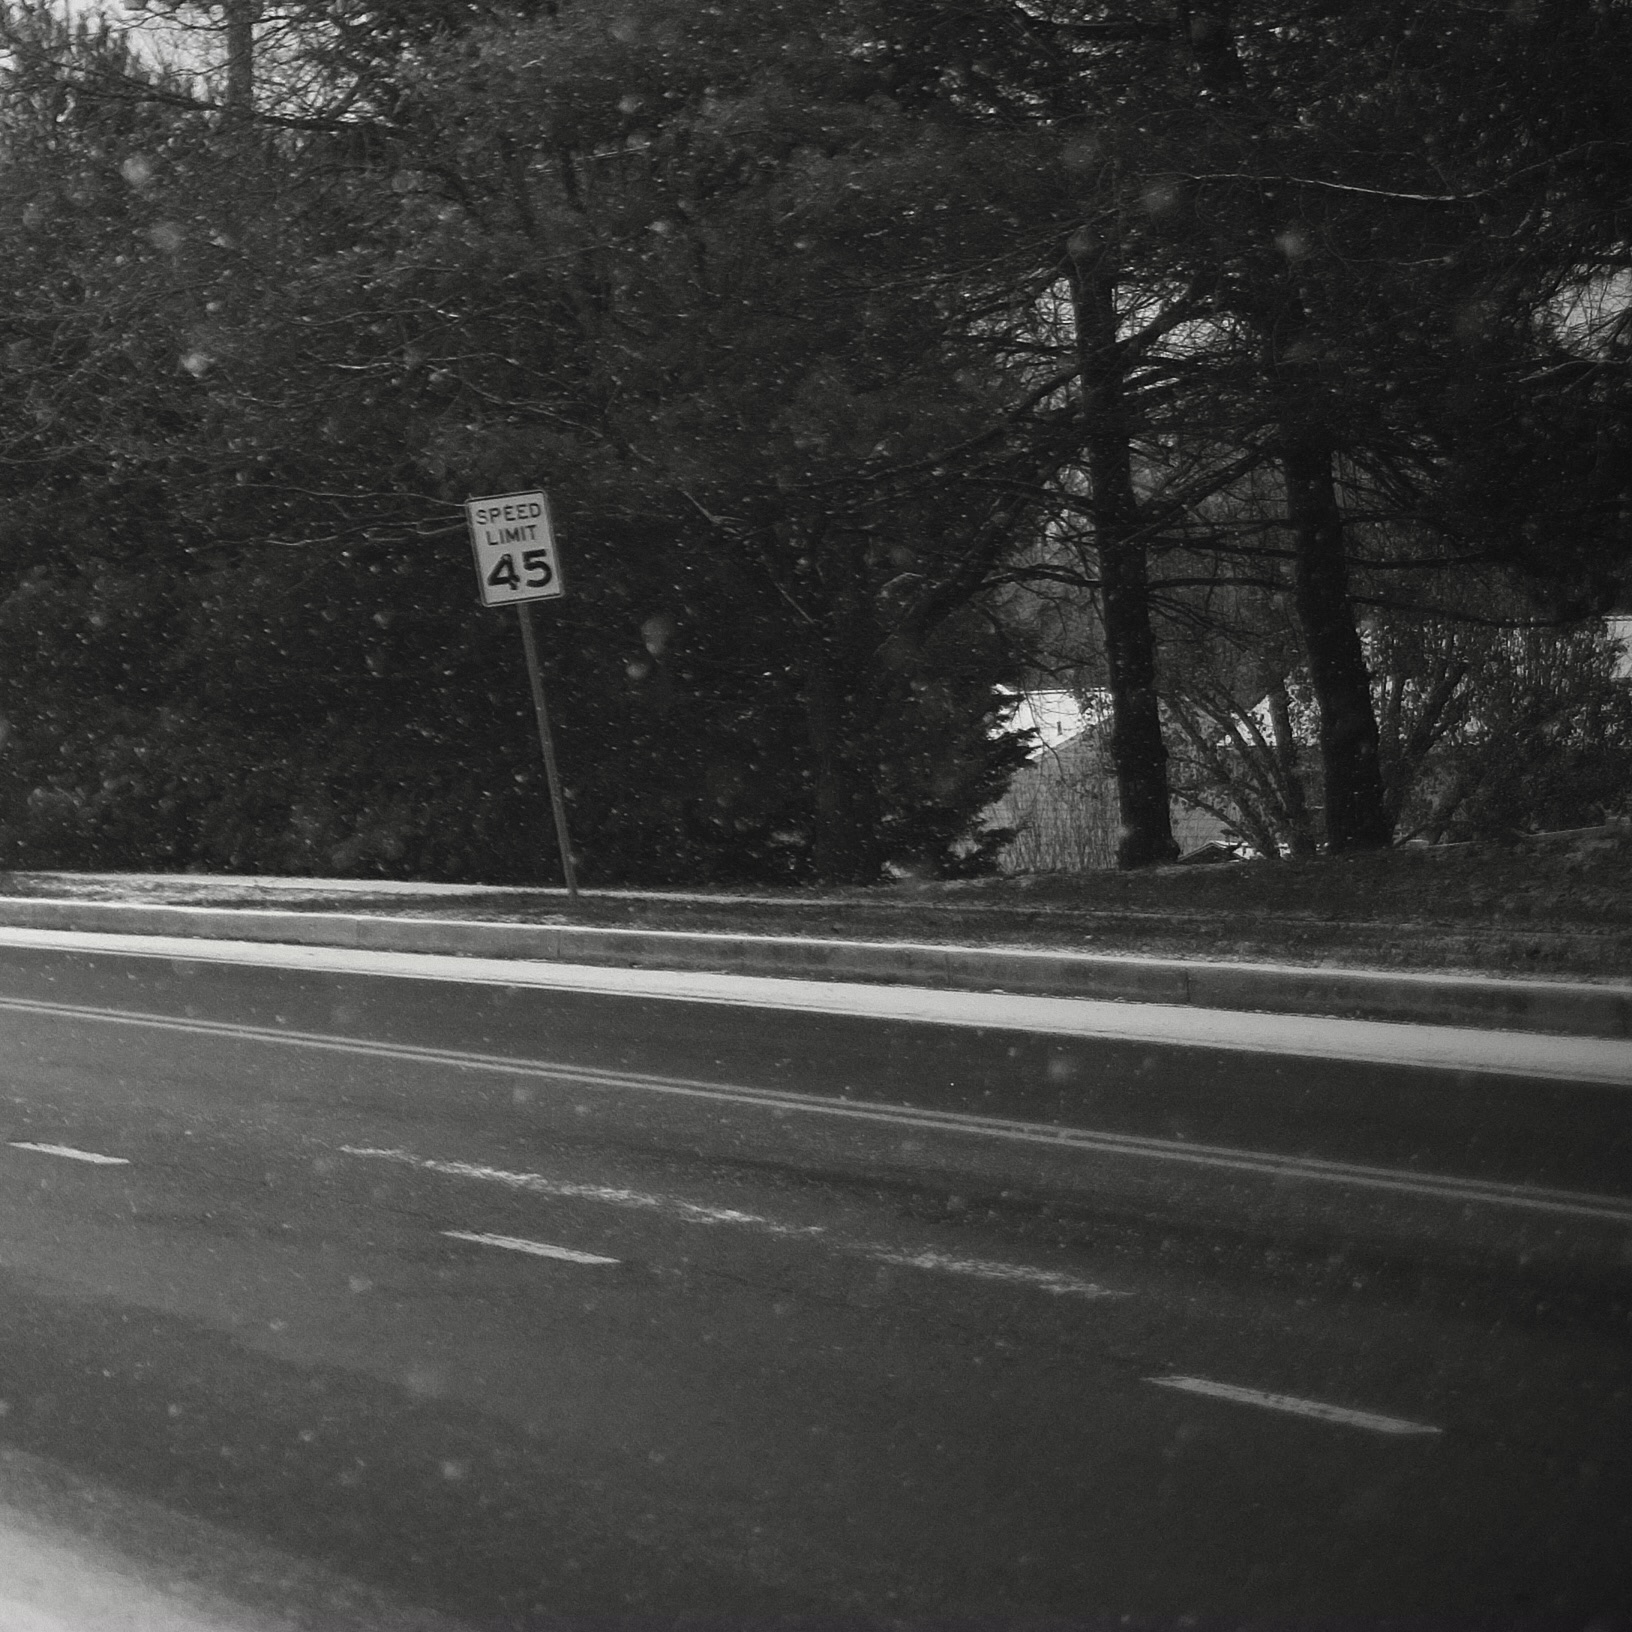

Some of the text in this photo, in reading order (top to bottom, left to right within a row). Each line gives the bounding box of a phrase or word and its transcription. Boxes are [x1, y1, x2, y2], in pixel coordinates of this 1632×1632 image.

[476, 503, 541, 525] SPEED
[486, 525, 537, 546] LIMIT
[487, 549, 552, 590] 45
